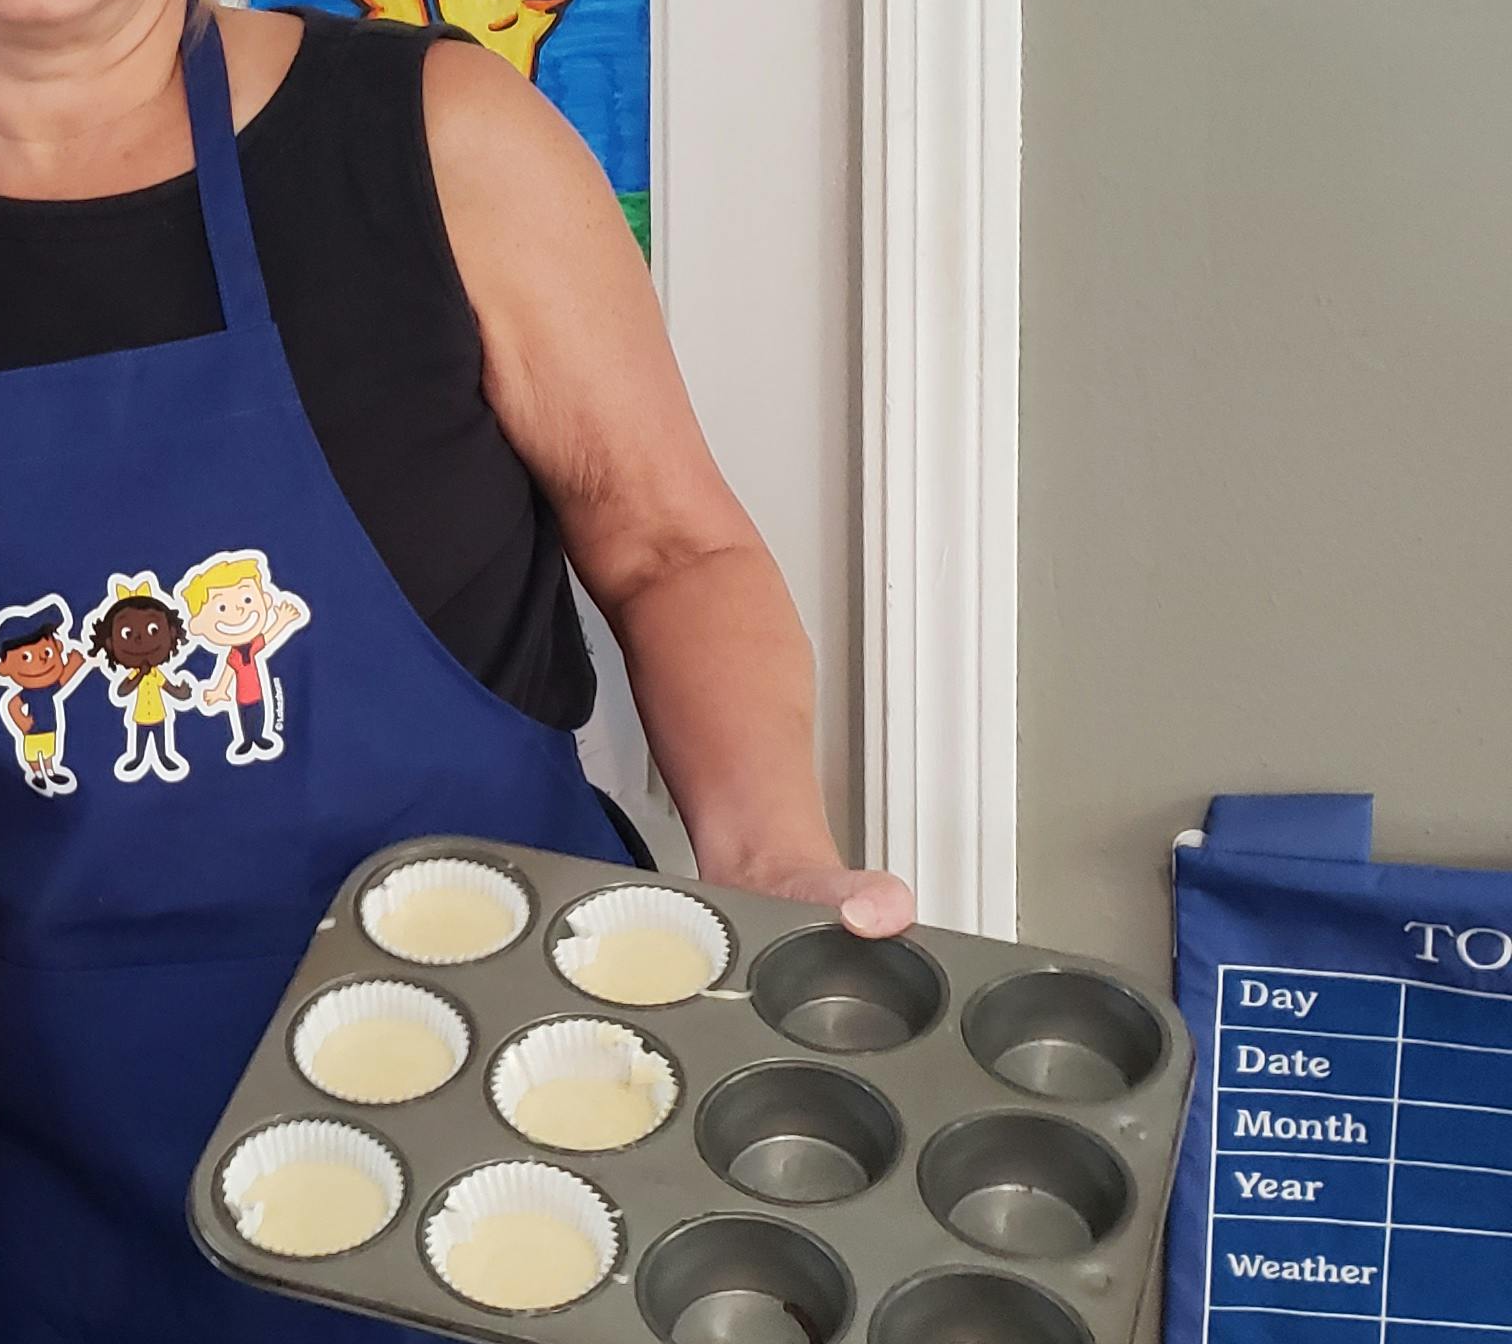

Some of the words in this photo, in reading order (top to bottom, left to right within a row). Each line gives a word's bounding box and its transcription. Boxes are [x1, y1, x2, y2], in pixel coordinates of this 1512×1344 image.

[1403, 920, 1512, 971] TO
[1240, 980, 1318, 1017] Day
[1237, 1044, 1331, 1078] Date
[1233, 1109, 1368, 1144] Month
[1234, 1171, 1324, 1202] Year
[1227, 1253, 1378, 1285] Weather
